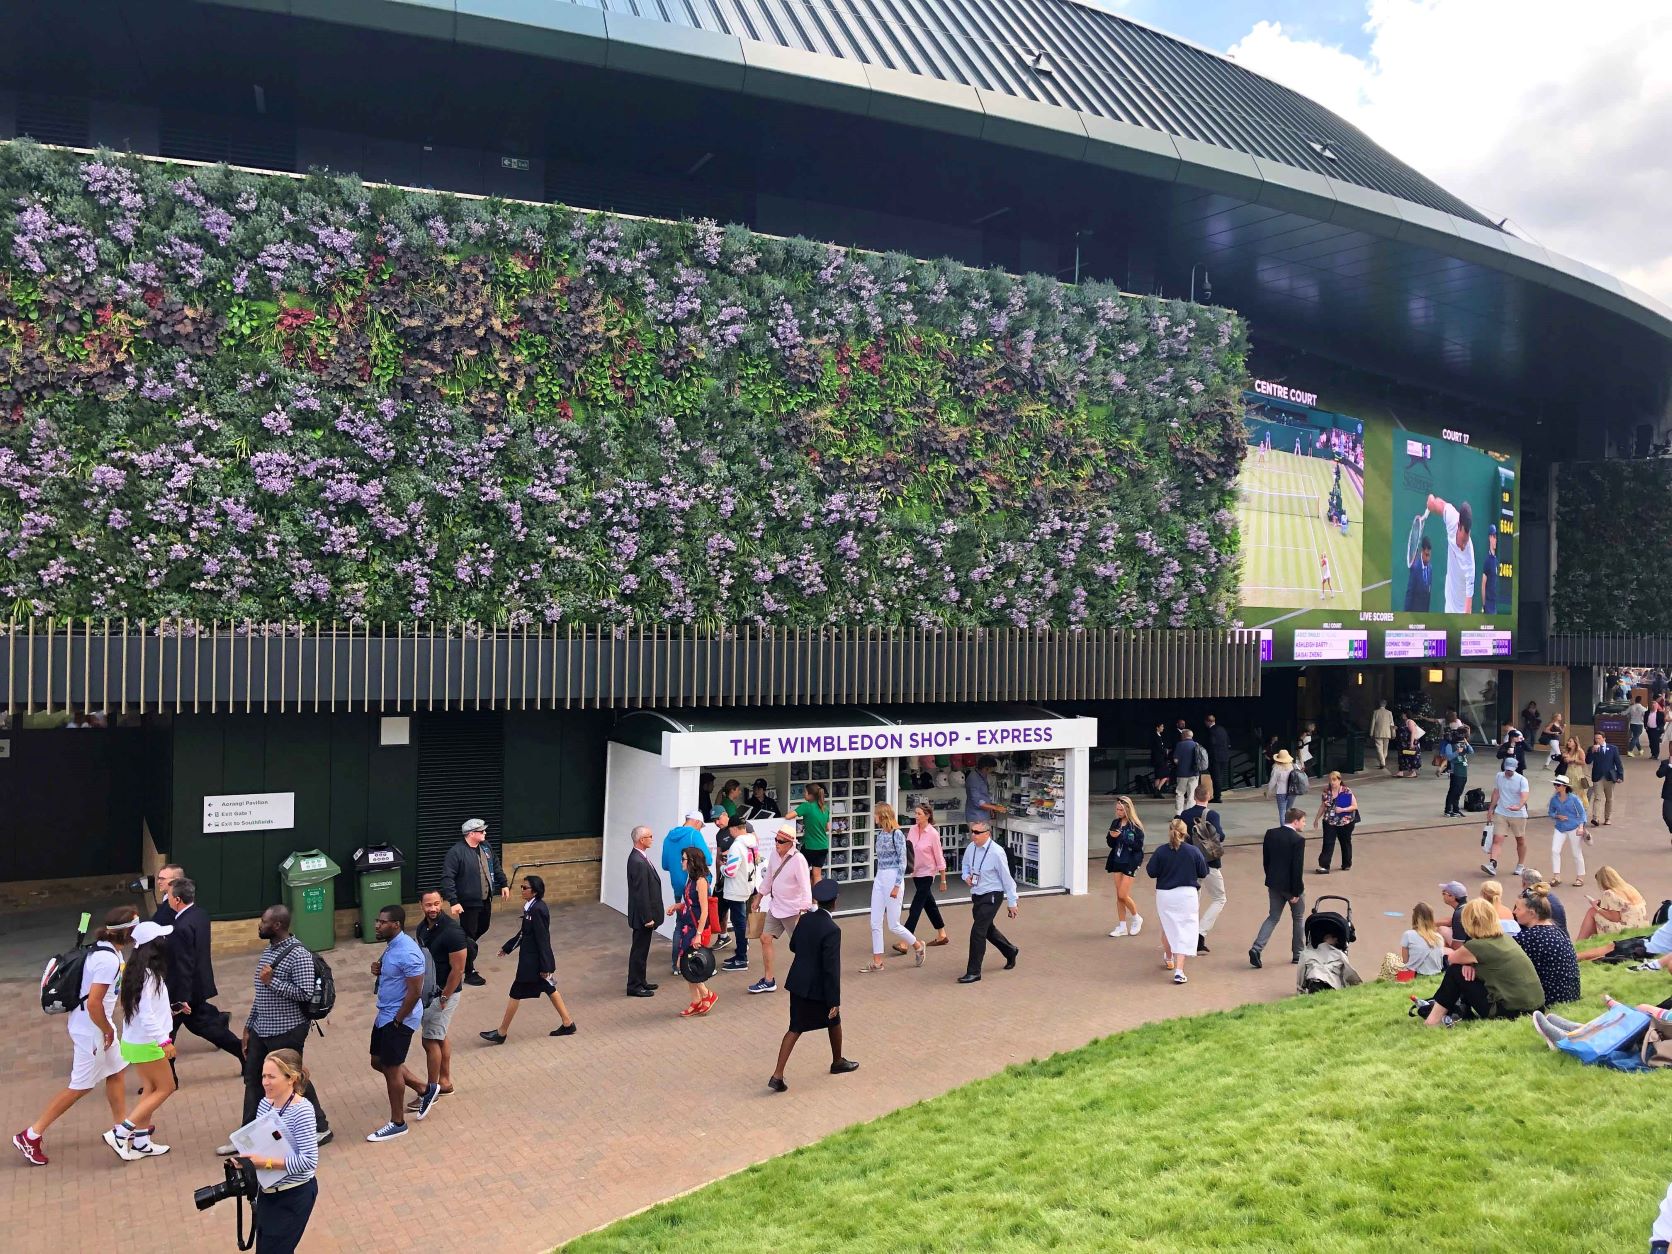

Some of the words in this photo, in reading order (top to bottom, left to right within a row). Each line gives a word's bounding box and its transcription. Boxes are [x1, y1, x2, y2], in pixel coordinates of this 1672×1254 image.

[1254, 379, 1289, 400] CENTRE
[1289, 388, 1318, 407] COURT
[1442, 428, 1462, 443] COURT
[1463, 433, 1470, 444] 17
[1359, 611, 1373, 621] LIVE
[1373, 612, 1394, 621] SCORES
[729, 738, 771, 756] THE
[778, 733, 903, 754] WIMBLEDON
[909, 730, 960, 749] SHOP
[977, 727, 1053, 745] EXPRESS
